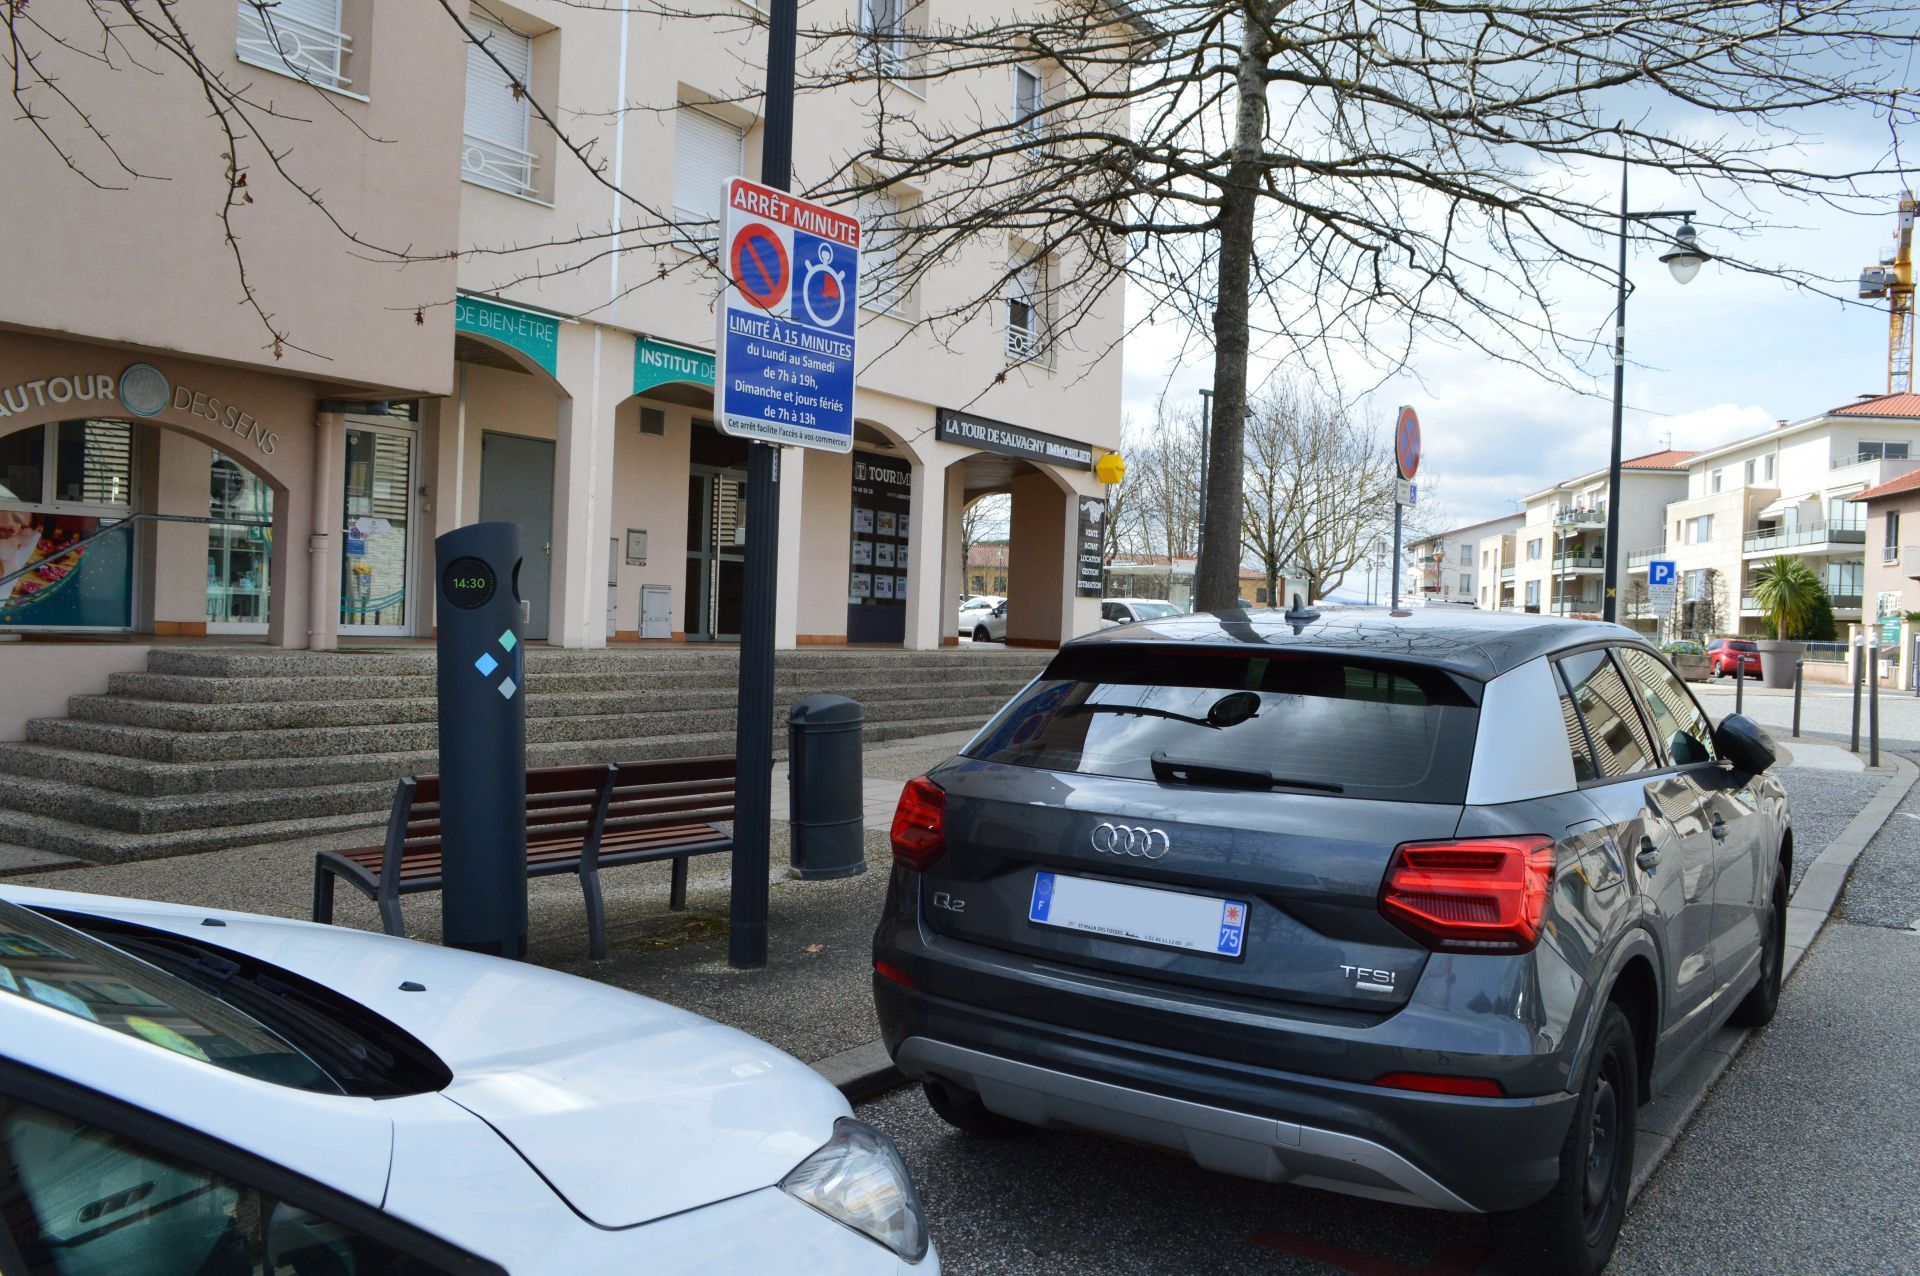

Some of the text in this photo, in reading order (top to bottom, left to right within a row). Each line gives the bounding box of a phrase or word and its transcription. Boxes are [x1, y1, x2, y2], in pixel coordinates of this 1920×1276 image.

[734, 187, 857, 244] ARRÊT MINUTE
[456, 303, 554, 342] DE BIEN-ÊTRE
[729, 315, 852, 358] LIMITÉ À 15 MINUTES
[641, 348, 716, 380] INSTITUT DE
[746, 342, 836, 374] du Lundi au Samedi
[763, 366, 818, 390] de 7h à 19h,
[735, 379, 844, 412] Dimanche et jours fériés
[173, 385, 220, 421] DES
[221, 405, 279, 456] SENS
[764, 405, 816, 426] de 7h à 13h
[728, 418, 848, 447] Cet arrêt facilite l'accès à vos commerces
[945, 418, 1092, 464] LA TOUR DE SALVAGNY IMMOBILIER
[1080, 554, 1101, 564] LOCATION
[1081, 567, 1099, 576] GESTION
[1655, 565, 1668, 582] P
[453, 578, 485, 589] 14:30
[1077, 580, 1102, 589] ESTIMATION
[934, 891, 965, 912] Q2
[1037, 900, 1045, 911] F
[1220, 928, 1239, 948] 75
[1340, 965, 1396, 984] TFSI
